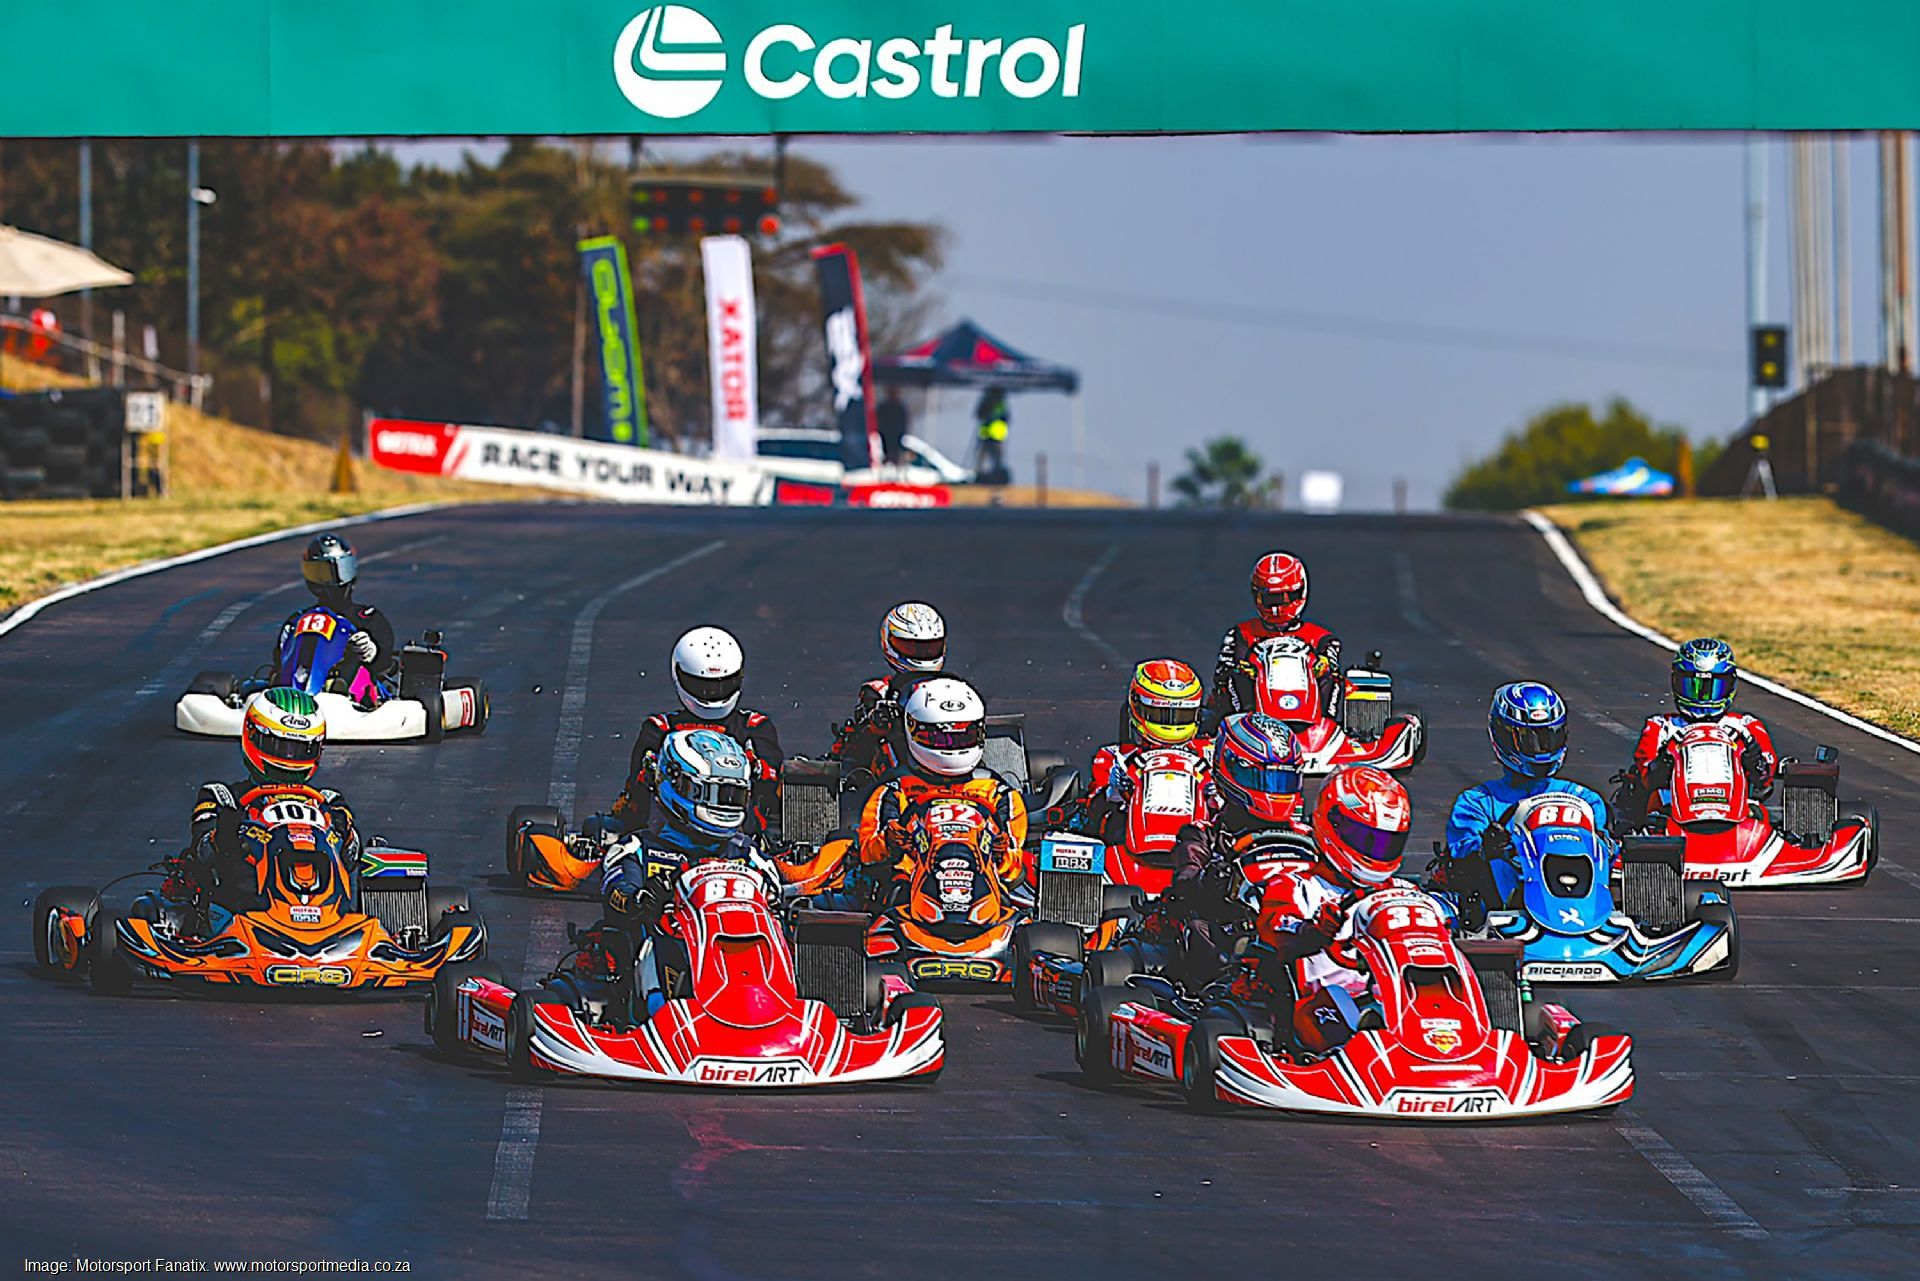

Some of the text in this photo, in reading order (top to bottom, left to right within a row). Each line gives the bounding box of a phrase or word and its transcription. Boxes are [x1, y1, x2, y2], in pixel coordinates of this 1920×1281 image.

[743, 23, 1086, 99] Castrol
[481, 442, 734, 502] RACE YOUR WAY
[302, 614, 327, 631] 13
[287, 715, 307, 727] Arai
[931, 804, 976, 825] 52
[1682, 868, 1752, 881] irelart
[1387, 906, 1439, 930] 33
[274, 968, 345, 984] CRG
[918, 962, 994, 979] CRG
[1528, 967, 1602, 975] RICCIARDO
[701, 1065, 801, 1082] birelART
[1397, 1096, 1498, 1113] birelART
